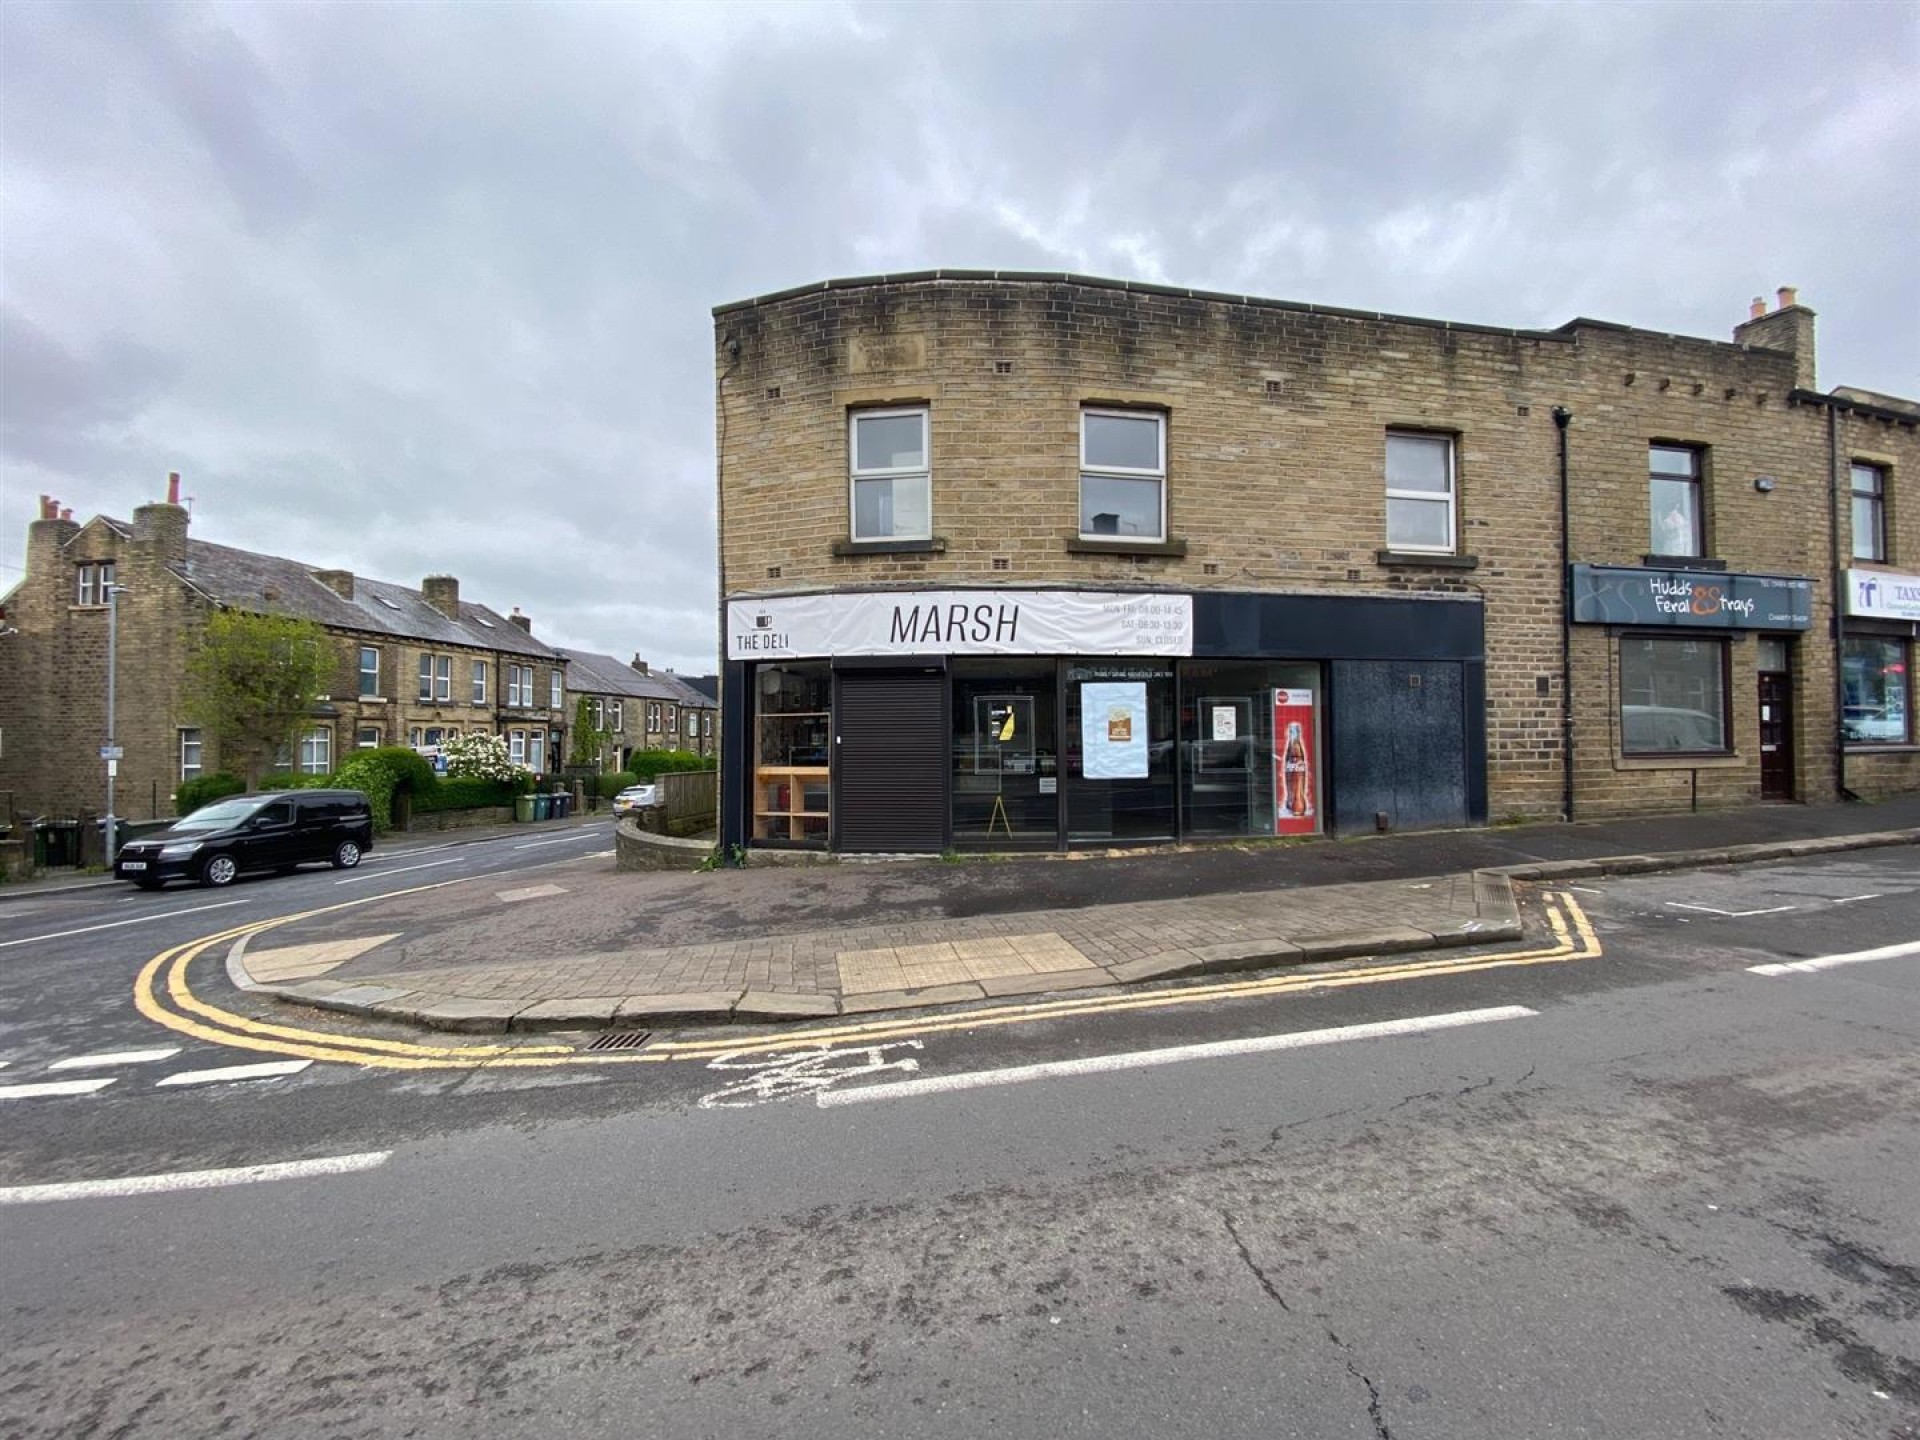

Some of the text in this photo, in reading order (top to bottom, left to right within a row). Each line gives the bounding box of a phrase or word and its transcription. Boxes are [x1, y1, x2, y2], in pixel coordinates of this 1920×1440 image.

[1650, 578, 1692, 596] Hudds
[1655, 595, 1690, 613] Feral
[890, 604, 1020, 644] MARSH
[736, 633, 789, 651] THE DELI
